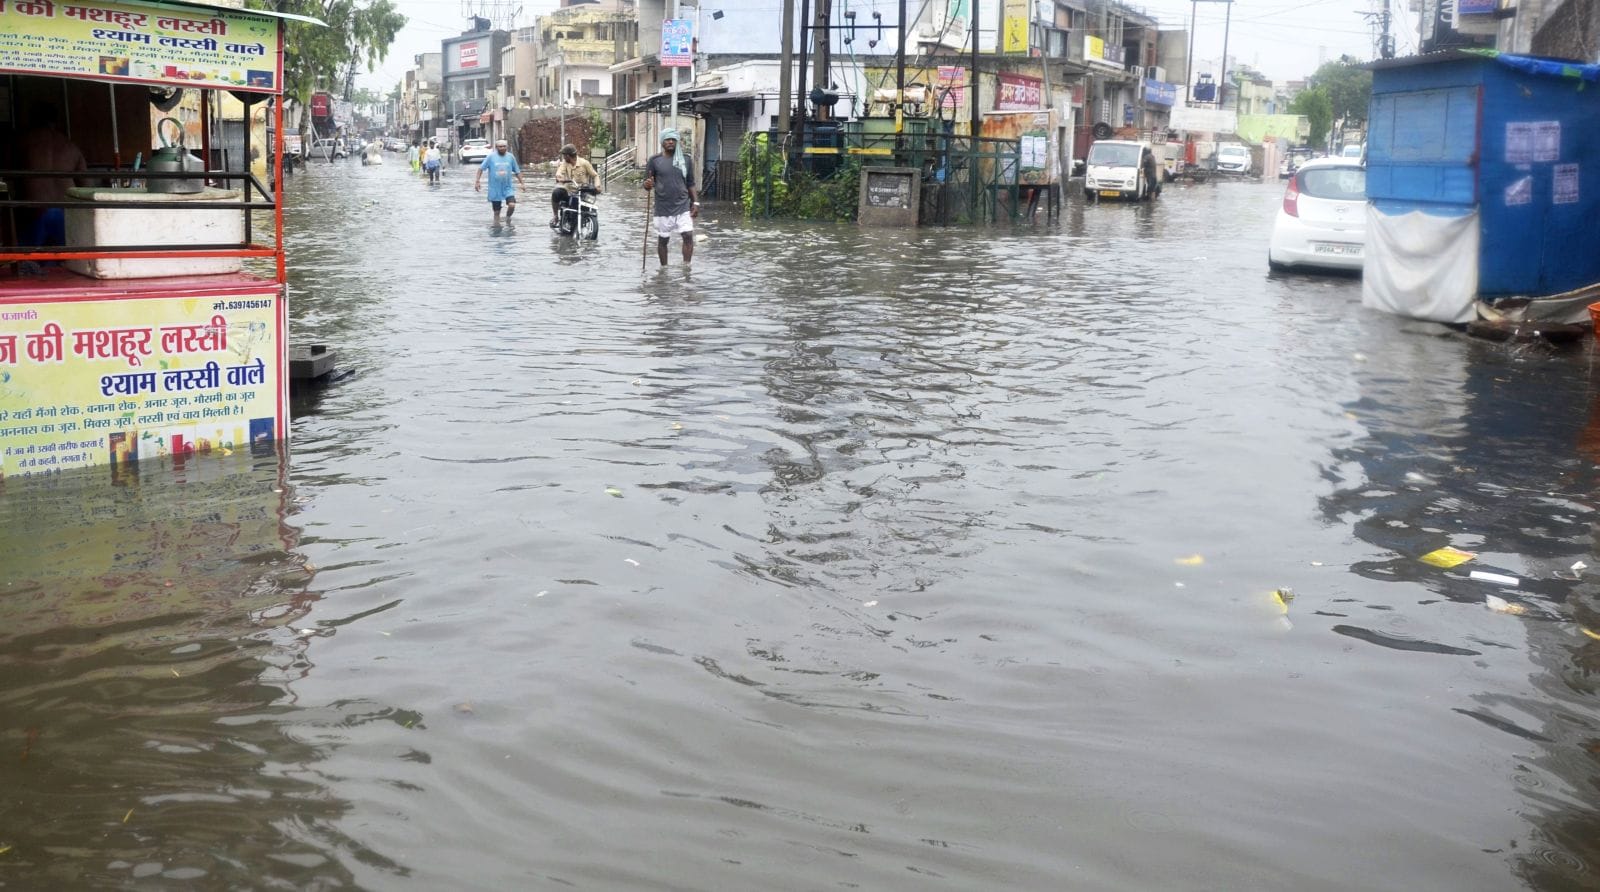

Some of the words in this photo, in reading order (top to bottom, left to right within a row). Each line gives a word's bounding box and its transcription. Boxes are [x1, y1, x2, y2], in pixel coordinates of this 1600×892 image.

[15, 0, 55, 17] की
[64, 6, 148, 31] मशहूर
[156, 15, 228, 36] लस्सी
[93, 29, 151, 45] श्याम
[158, 36, 218, 51] लस्सी
[225, 43, 266, 56] वाले
[25, 323, 64, 362] की
[72, 328, 153, 366] मशहूर
[160, 315, 228, 353] लस्सी
[101, 372, 157, 397] श्याम
[163, 361, 220, 391] लस्सी
[226, 358, 266, 386] वाले
[225, 392, 237, 401] का
[41, 424, 55, 433] का
